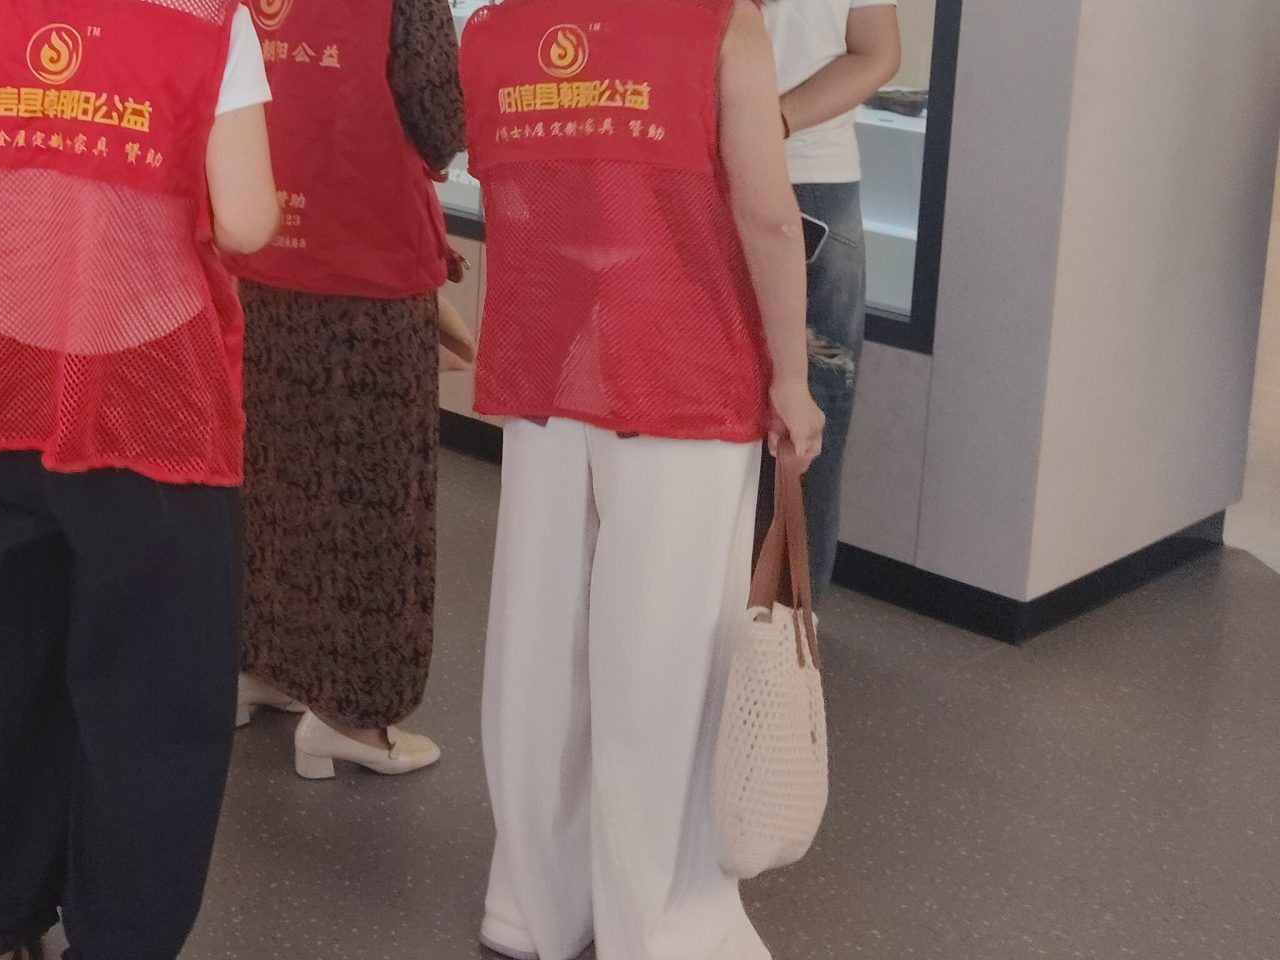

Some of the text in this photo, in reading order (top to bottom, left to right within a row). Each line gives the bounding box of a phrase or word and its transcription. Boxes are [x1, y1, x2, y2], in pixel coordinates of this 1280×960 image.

[498, 79, 652, 114] 阳信县朝阳公益
